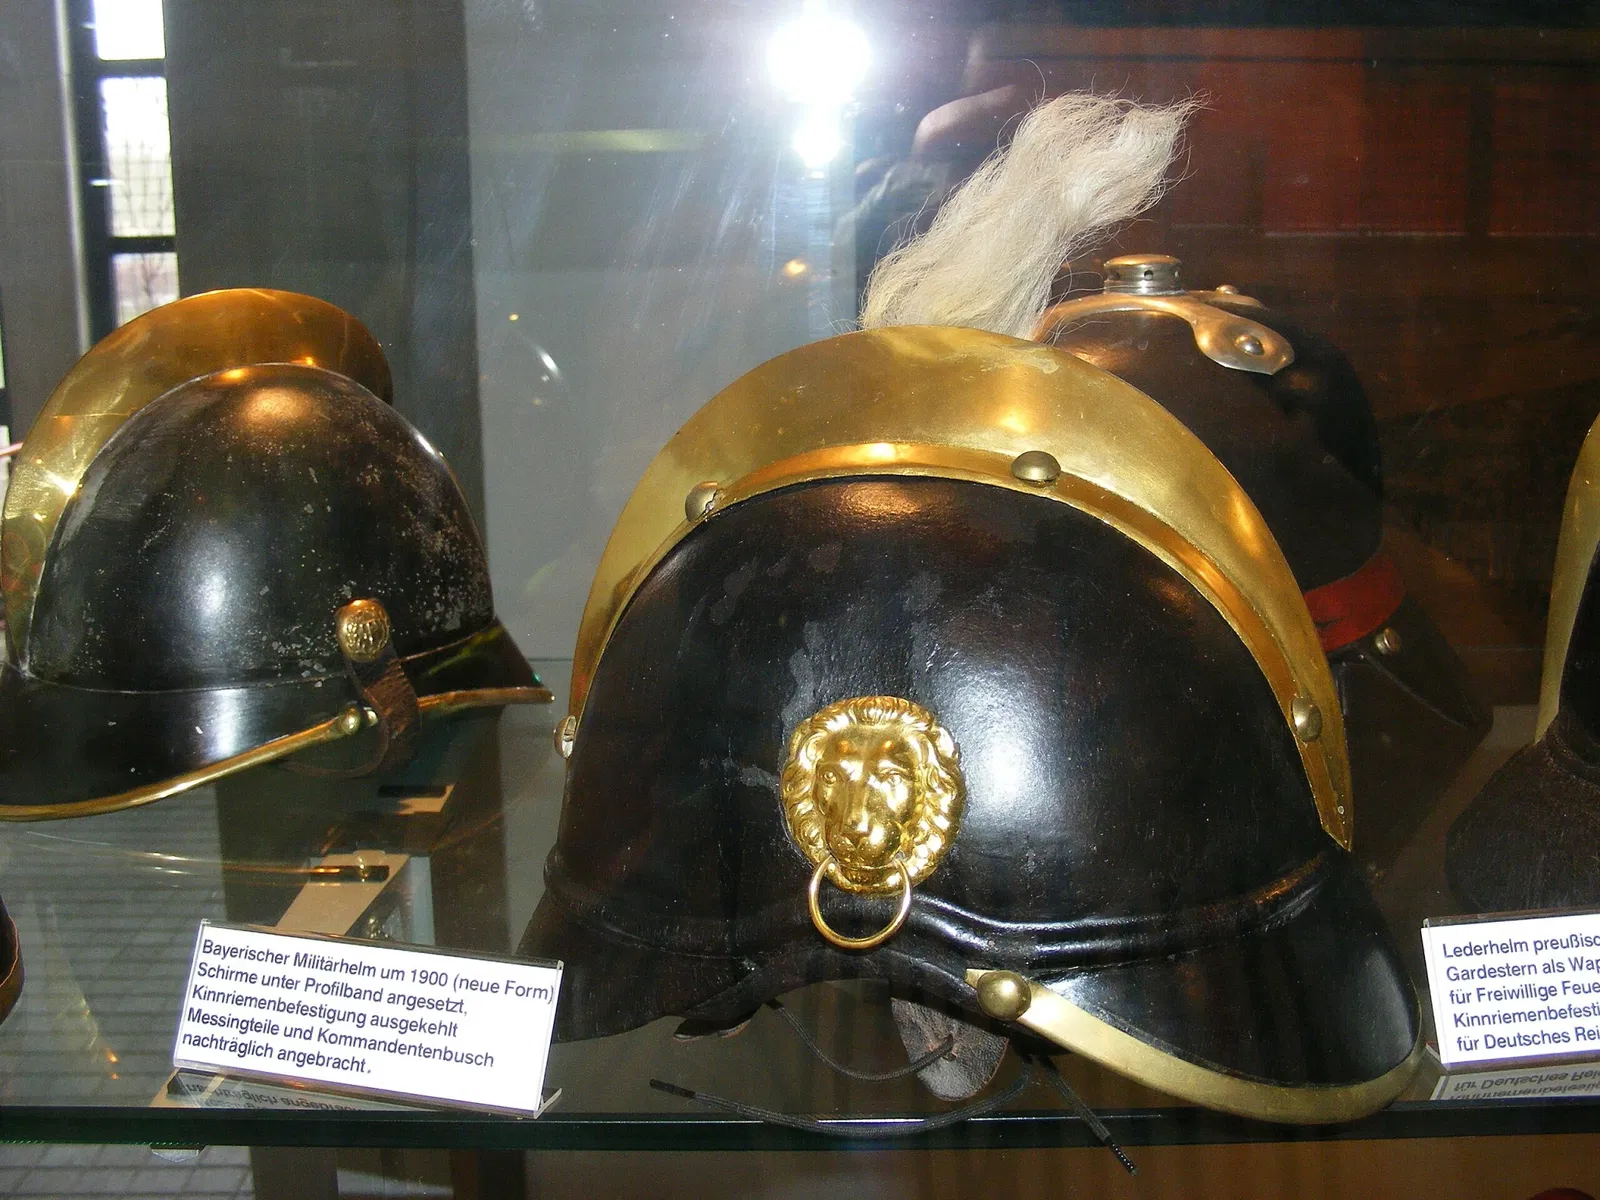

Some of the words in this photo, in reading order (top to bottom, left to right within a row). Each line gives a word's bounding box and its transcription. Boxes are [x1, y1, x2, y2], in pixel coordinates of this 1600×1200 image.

[1442, 938, 1529, 958] Lederhelm
[197, 962, 258, 985] Schirme
[261, 974, 301, 992] unter
[304, 978, 383, 1004] Profilband
[386, 992, 468, 1016] angesetzt,
[203, 939, 291, 966] Bayerischer
[293, 951, 377, 978] Militärhelm
[380, 967, 406, 982] um
[410, 968, 448, 988] 1900
[453, 973, 501, 995] (neue
[505, 980, 555, 1004] Form)
[1446, 963, 1537, 981] Gardestern
[1542, 959, 1565, 975] als
[192, 985, 367, 1028] Kinnriemenbefestigung
[370, 1013, 459, 1038] ausgekehlt
[1449, 988, 1472, 1005] für
[1476, 984, 1557, 1002] Freiwillige
[1562, 980, 1600, 995] Feue
[182, 1033, 274, 1058] nachträglich
[277, 1047, 372, 1074] angebracht.
[187, 1007, 280, 1035] Messingteile
[284, 1023, 314, 1040] und
[317, 1028, 495, 1067] Kommandentenbusch
[1457, 1037, 1479, 1052] für
[1484, 1031, 1570, 1049] Deutsches
